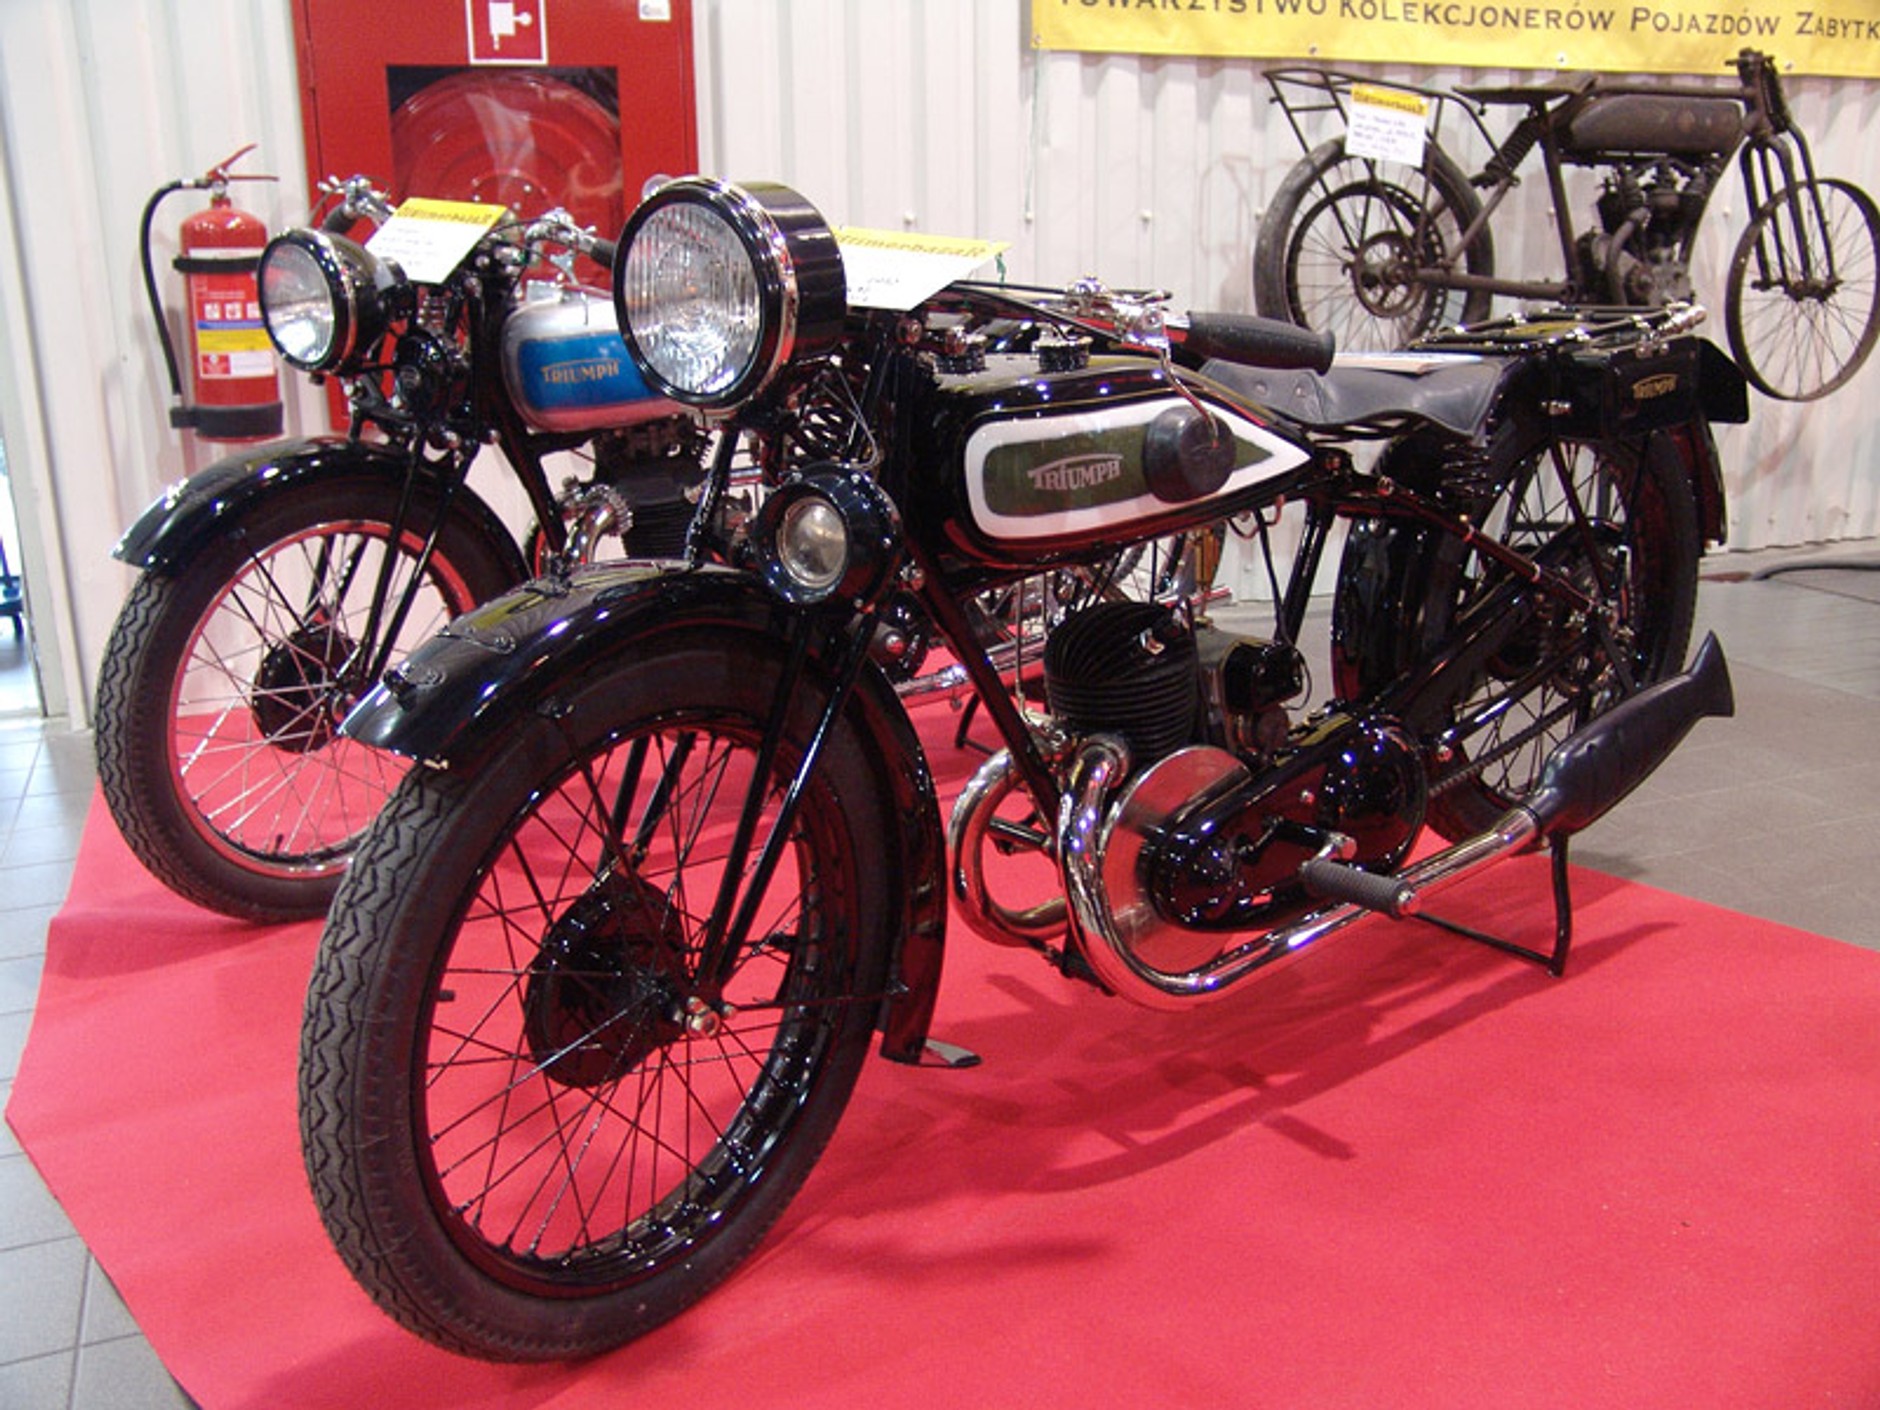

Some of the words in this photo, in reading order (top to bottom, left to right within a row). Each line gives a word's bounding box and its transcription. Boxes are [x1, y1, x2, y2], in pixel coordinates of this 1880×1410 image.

[1061, 0, 1327, 15] ZYSTWO
[1339, 0, 1615, 31] KOLEKCJONERÓW
[1631, 7, 1781, 36] POJAZDÓW
[540, 357, 620, 384] TRIUMPH
[1027, 453, 1123, 490] TRIUMPH
